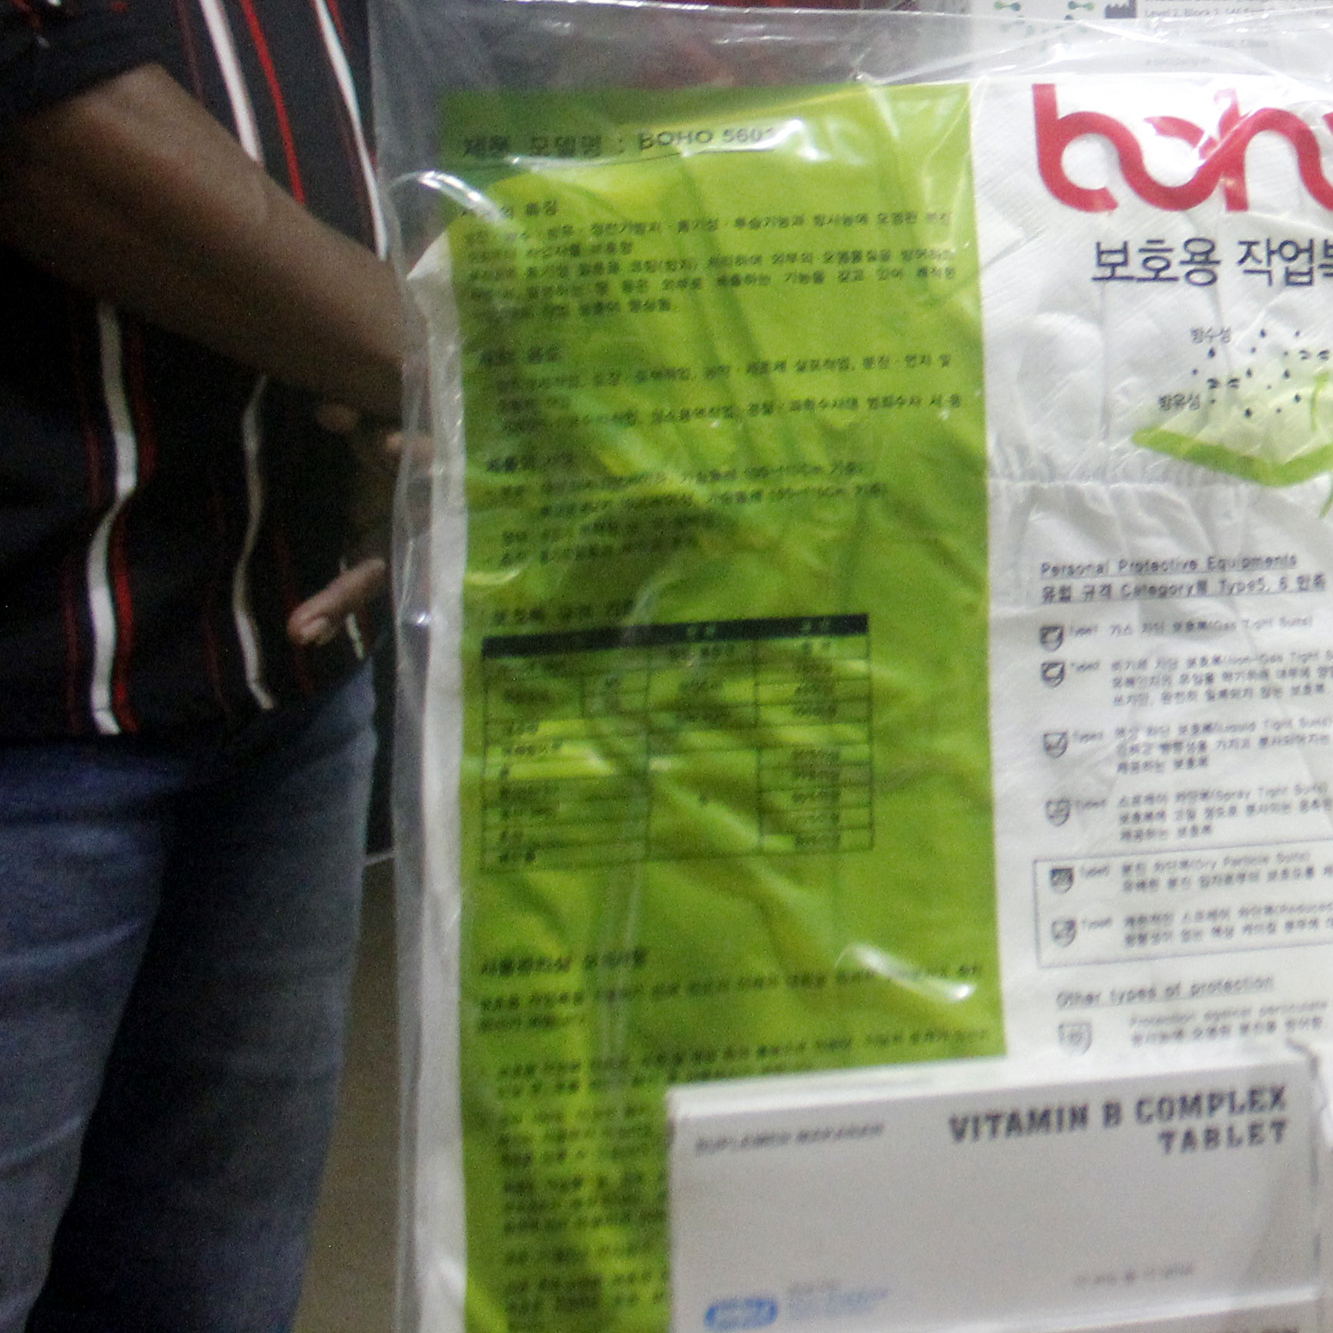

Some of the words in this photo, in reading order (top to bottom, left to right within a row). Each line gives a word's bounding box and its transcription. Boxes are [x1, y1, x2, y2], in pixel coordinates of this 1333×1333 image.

[638, 128, 713, 151] BOHO
[1091, 237, 1222, 287] 보호용
[1040, 560, 1110, 577] Personal
[1118, 557, 1199, 574] Protective
[948, 1100, 1090, 1146] VITAMIN
[1103, 1095, 1122, 1129] B
[1134, 1083, 1288, 1126] COMPLEX
[1158, 1119, 1290, 1156] TABLET
